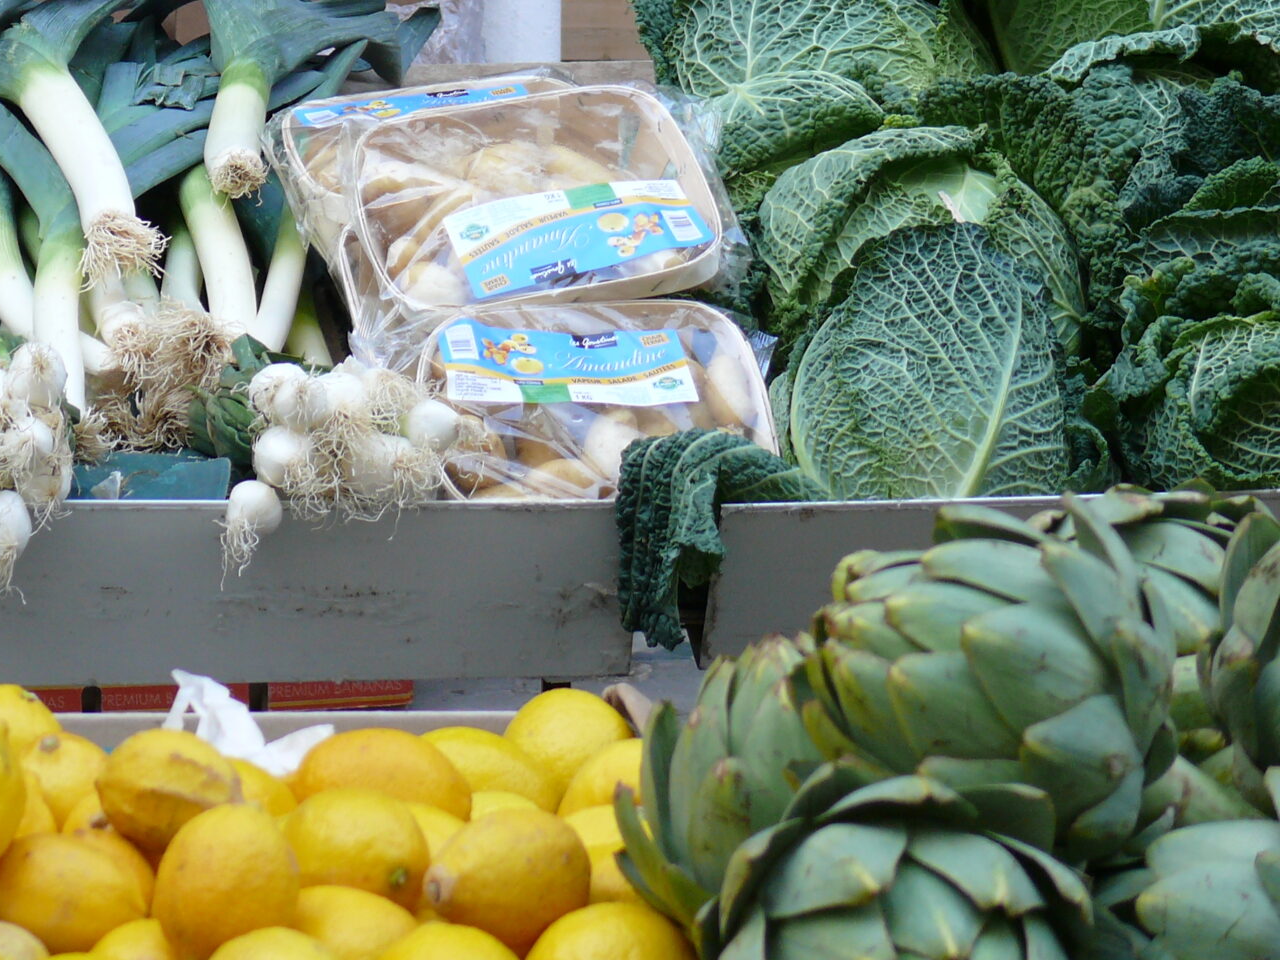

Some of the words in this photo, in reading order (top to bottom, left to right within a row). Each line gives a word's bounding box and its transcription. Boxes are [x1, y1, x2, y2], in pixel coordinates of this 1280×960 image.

[540, 210, 569, 224] VAPEUR
[503, 221, 535, 238] SALADE
[554, 347, 667, 373] Amandine
[571, 377, 602, 385] VAPEUR
[607, 375, 638, 385] SALADE
[268, 685, 329, 698] PREMIUM
[101, 693, 162, 707] PREMIUM
